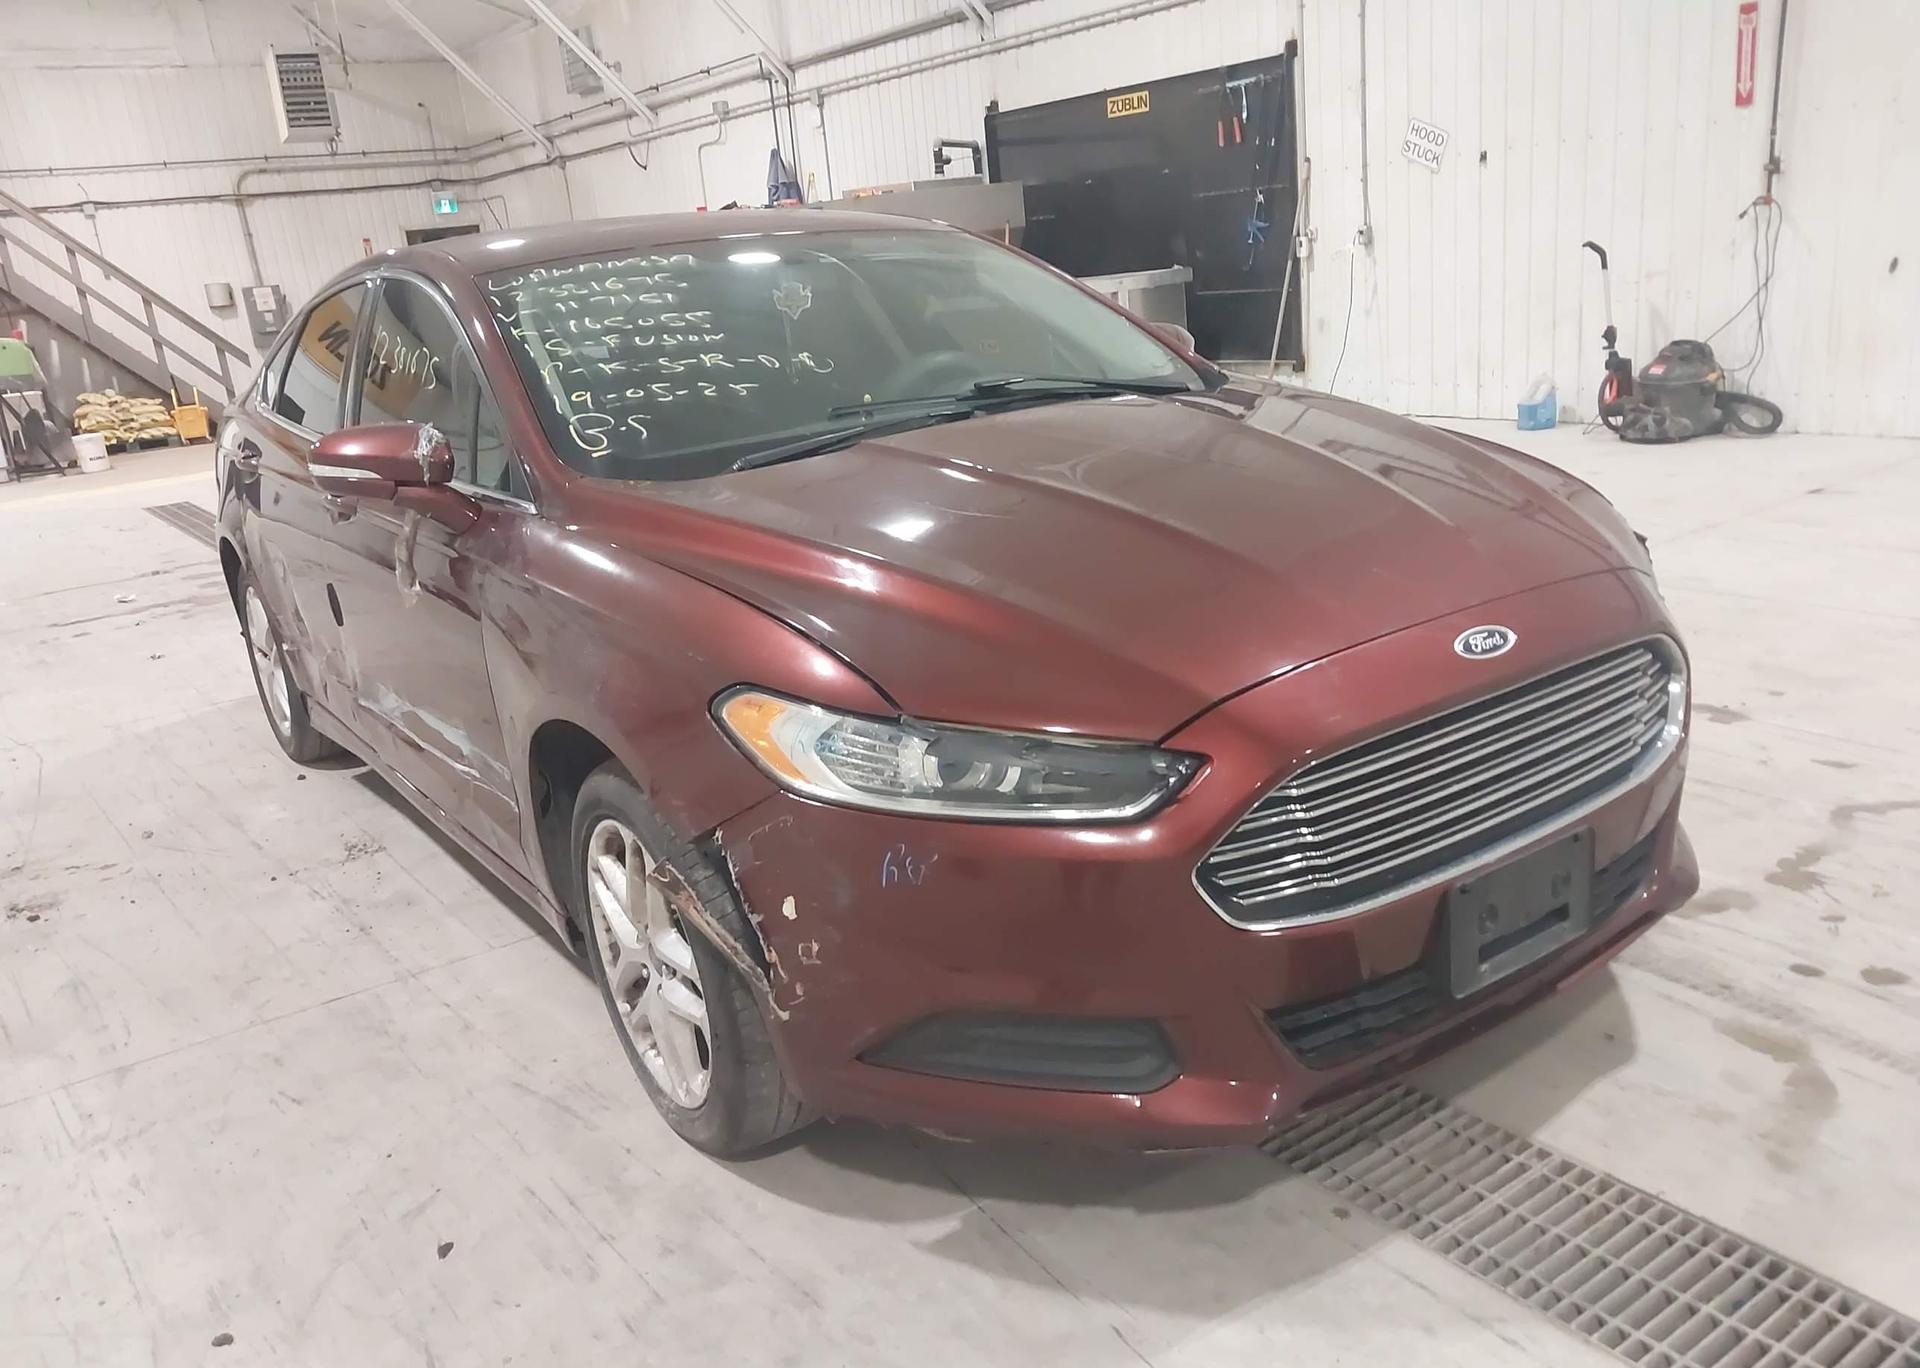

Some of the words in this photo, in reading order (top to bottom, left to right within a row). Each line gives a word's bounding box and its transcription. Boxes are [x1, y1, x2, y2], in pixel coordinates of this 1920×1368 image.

[1410, 122, 1445, 147] HOOD
[1403, 139, 1441, 167] STUCK
[1468, 631, 1505, 653] Ford
